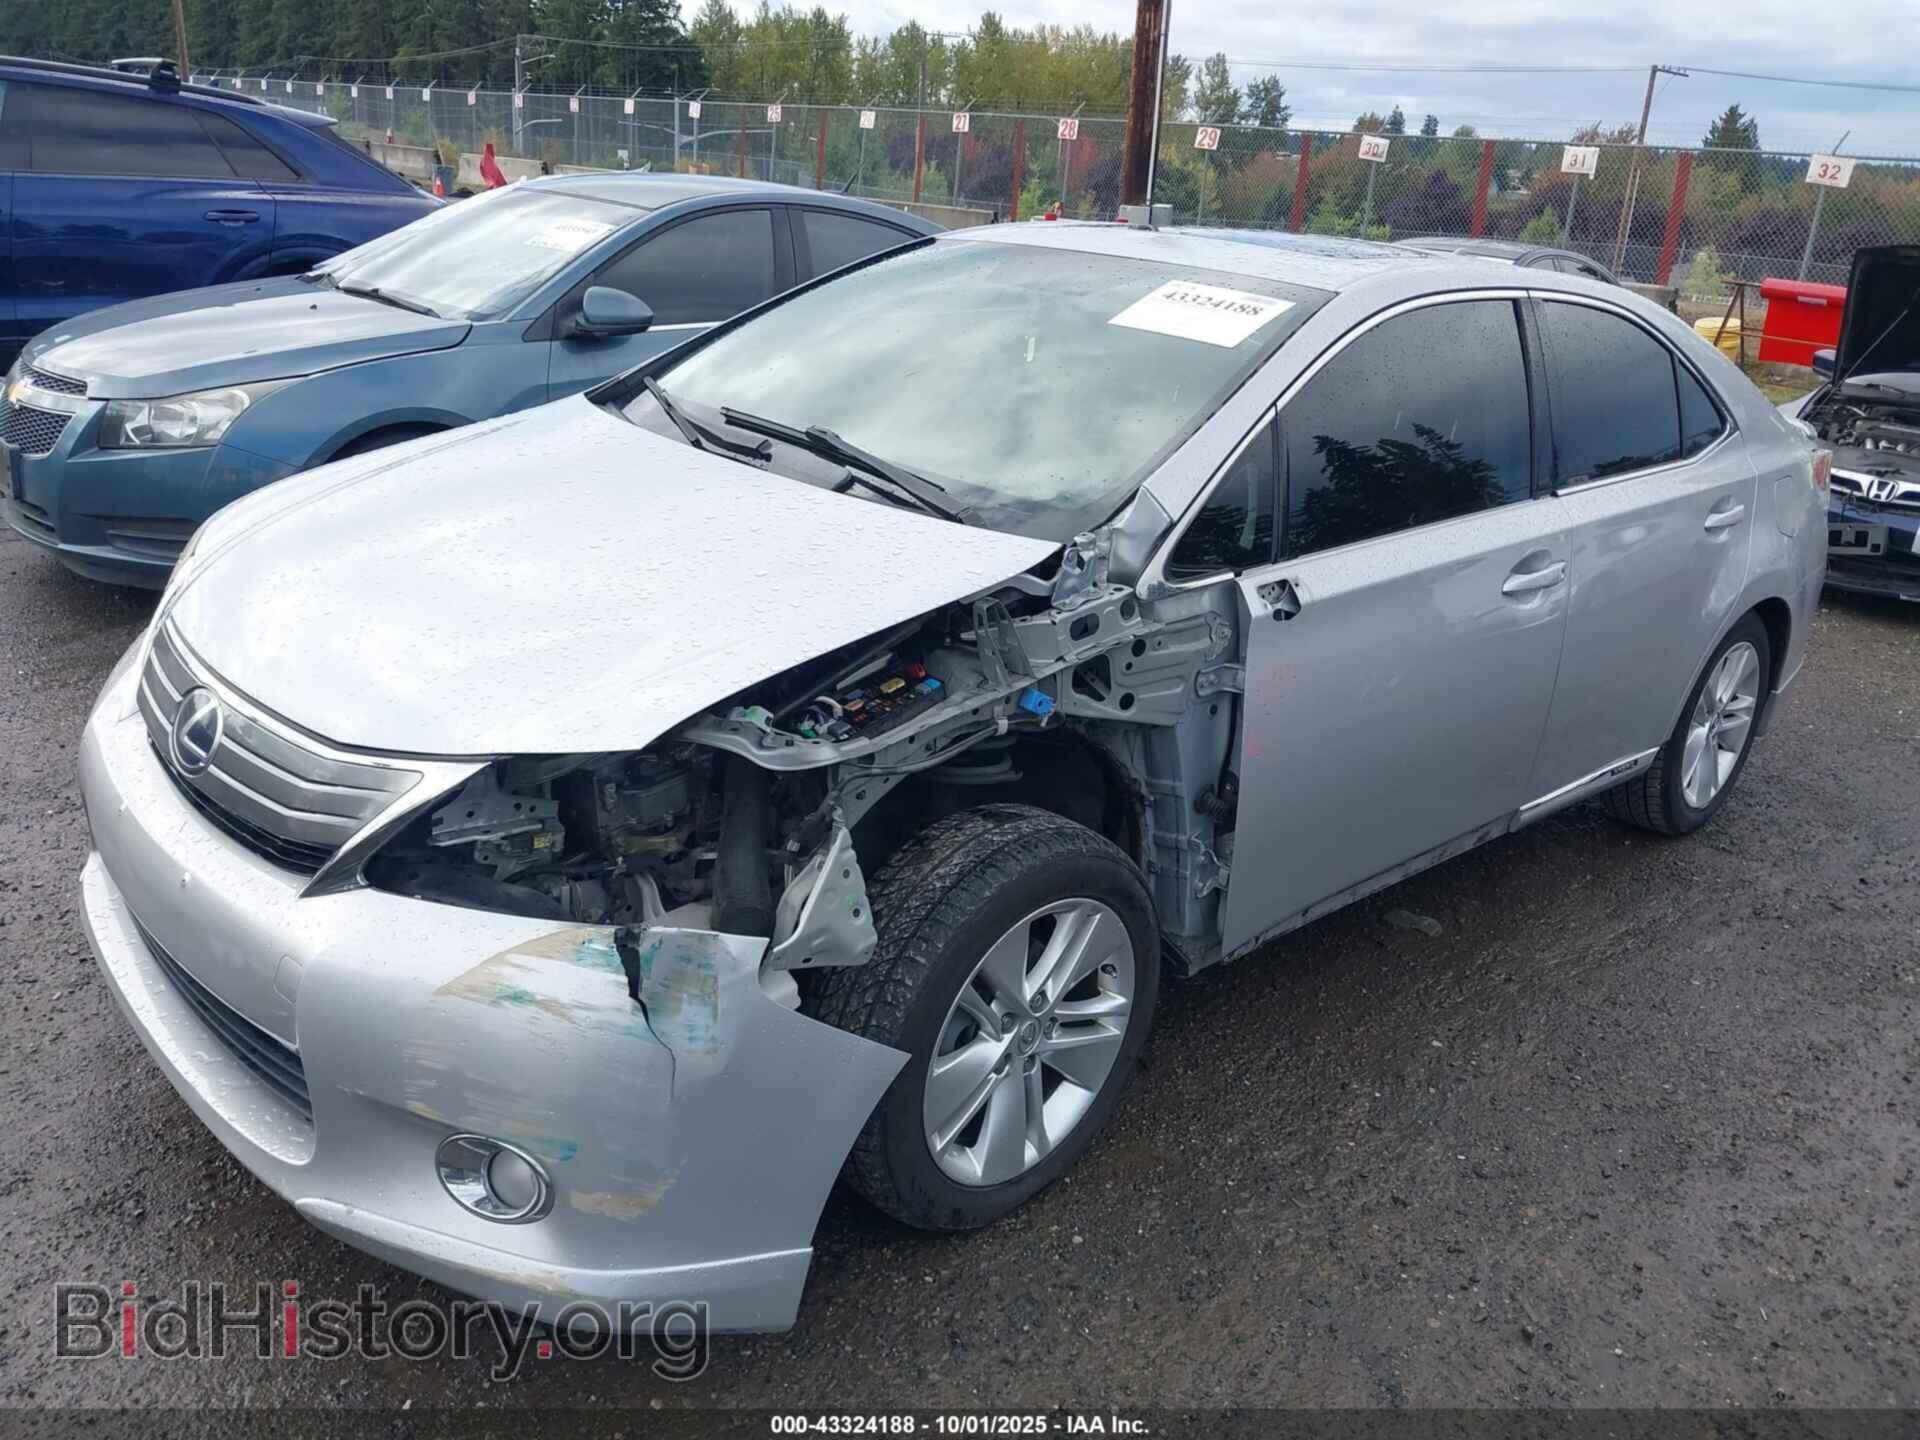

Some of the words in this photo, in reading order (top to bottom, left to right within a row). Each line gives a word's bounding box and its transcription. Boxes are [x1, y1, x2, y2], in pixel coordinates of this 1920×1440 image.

[954, 114, 967, 130] 27
[1060, 120, 1077, 138] 28
[1198, 129, 1217, 148] 29
[1365, 143, 1380, 156] 30
[1570, 154, 1585, 168] 31
[1818, 163, 1841, 180] 32
[1163, 290, 1264, 316] 43324188
